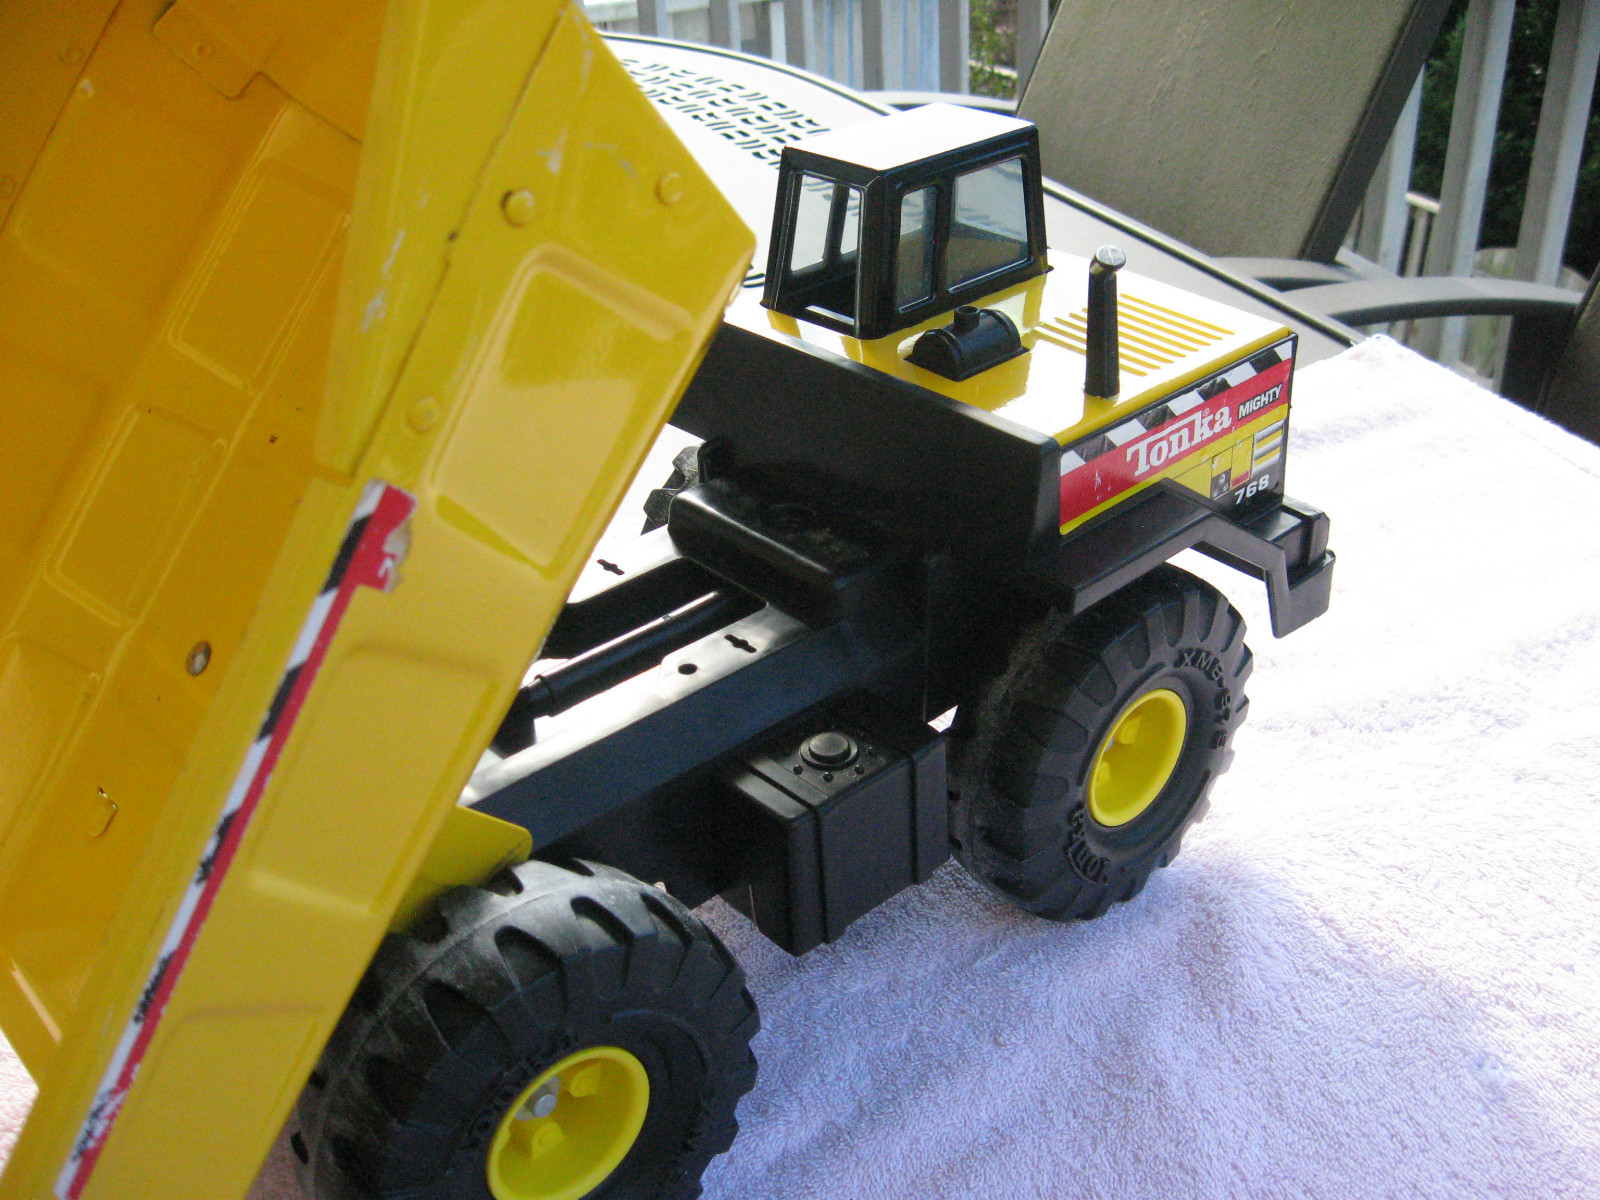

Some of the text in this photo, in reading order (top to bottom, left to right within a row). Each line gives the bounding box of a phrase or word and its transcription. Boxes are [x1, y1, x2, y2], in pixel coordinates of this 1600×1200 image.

[1125, 383, 1283, 477] Tonka MIGHTY
[1234, 474, 1270, 505] 768
